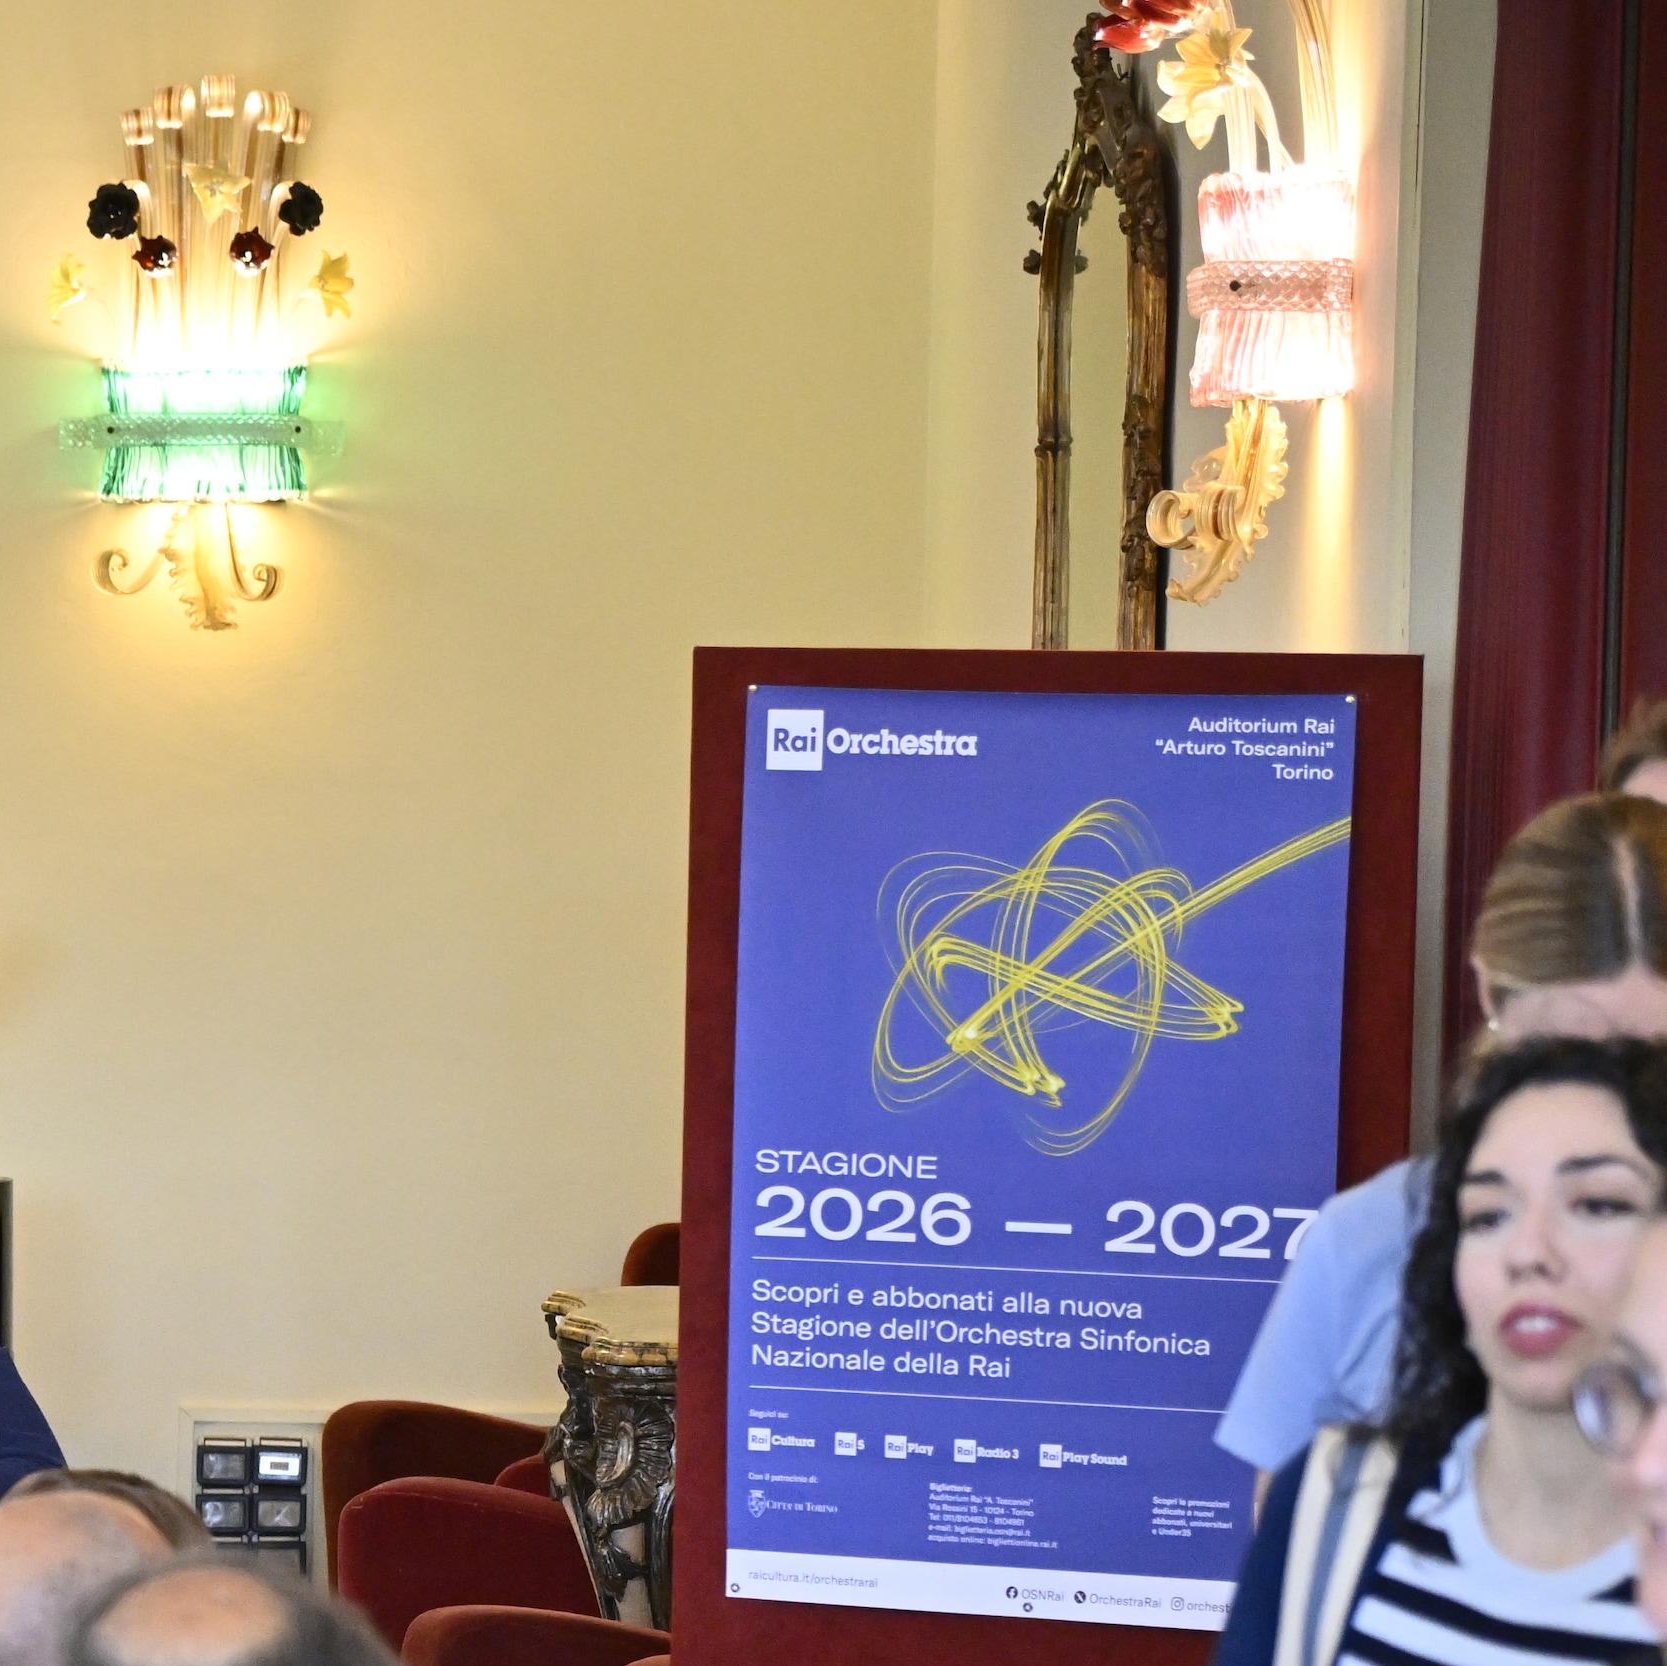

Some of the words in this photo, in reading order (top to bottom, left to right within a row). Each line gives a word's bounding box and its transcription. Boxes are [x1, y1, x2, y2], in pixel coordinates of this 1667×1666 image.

[1188, 717, 1298, 734] Auditorium
[1304, 718, 1335, 735] Rai
[773, 727, 817, 752] Rai
[826, 727, 978, 756] Orchestra
[1271, 763, 1334, 780] Torino
[755, 1149, 938, 1180] STAGIONE
[754, 1185, 972, 1246] 2026
[1104, 1200, 1319, 1260] 2027
[751, 1278, 839, 1308] Scopri
[847, 1288, 864, 1305] e
[872, 1285, 993, 1312] abbonati
[1002, 1291, 1050, 1315] alla
[1060, 1298, 1142, 1319] nuova
[751, 1311, 871, 1341] Stagione
[1079, 1327, 1210, 1356] Sinfonica
[752, 1343, 885, 1372] Nazionale
[893, 1351, 959, 1376] della
[969, 1354, 1010, 1378] Rai
[771, 1434, 816, 1447] Cultura
[857, 1438, 865, 1450] 5
[907, 1442, 934, 1456] Play
[977, 1446, 1011, 1459] Radio
[1012, 1449, 1020, 1459] 3
[1062, 1451, 1089, 1465] Play
[1090, 1453, 1128, 1466] Sound
[771, 1473, 808, 1483] patrocinio
[748, 1570, 878, 1588] raicultura.it/orchestrarai
[1021, 1588, 1065, 1602] OSNRai
[1089, 1593, 1162, 1609] OrchestraRai
[1187, 1601, 1230, 1613] orchest
